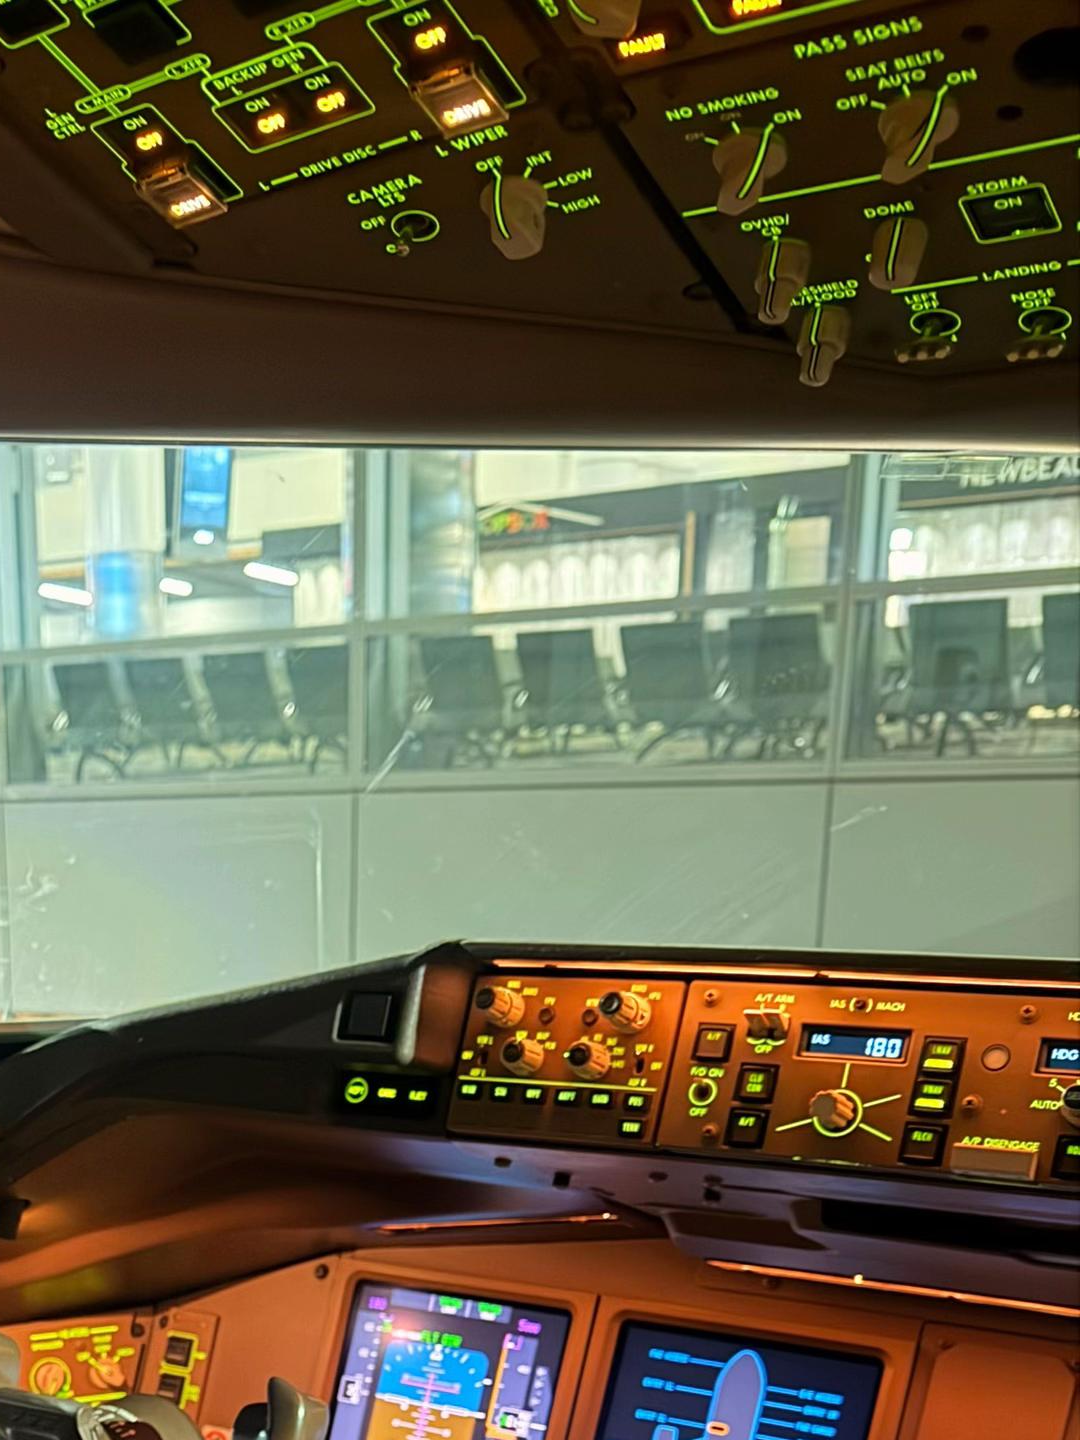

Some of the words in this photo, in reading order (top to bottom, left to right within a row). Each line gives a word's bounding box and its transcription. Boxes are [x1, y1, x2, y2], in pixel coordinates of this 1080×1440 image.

[403, 8, 431, 26] ON
[793, 34, 847, 59] PASS
[852, 16, 922, 45] SIGNS
[212, 62, 267, 91] BACKUP
[271, 48, 306, 68] GEN
[291, 62, 303, 74] R
[845, 61, 888, 82] SEAT
[893, 48, 945, 70] BELTS
[304, 73, 331, 91] ON
[878, 68, 926, 91] AUTO
[945, 68, 978, 86] ON
[231, 86, 243, 96] L
[244, 97, 271, 112] ON
[665, 106, 693, 122] NO
[697, 86, 780, 115] SMOKING
[836, 93, 868, 110] OFF
[46, 112, 76, 131] GEN
[123, 115, 148, 131] ON
[773, 108, 802, 124] ON
[53, 123, 86, 139] CTRL
[410, 130, 423, 141] R
[435, 145, 449, 158] L
[451, 124, 508, 152] WIPER
[299, 156, 342, 178] DRIVE
[342, 145, 377, 163] DISC
[475, 155, 503, 172] OFF
[526, 150, 552, 167] INT
[259, 181, 271, 191] L
[558, 168, 593, 187] LOW
[966, 175, 1027, 196] STORM
[347, 174, 422, 204] CAMERA
[377, 192, 406, 208] LTS
[561, 194, 601, 214] HIGH
[993, 196, 1023, 210] ON
[863, 200, 915, 219] DOME
[360, 215, 387, 231] OFF
[740, 213, 790, 233] OVHD/
[761, 226, 782, 237] CB
[982, 261, 1062, 282] LANDING
[790, 289, 857, 306] L/FLOOD
[903, 291, 938, 305] LEFT
[1010, 287, 1056, 304] NOSE
[1021, 298, 1052, 309] OFF
[911, 300, 940, 311] OFF
[829, 999, 846, 1009] IAS
[875, 1001, 906, 1012] MACH
[754, 1044, 774, 1054] OFF
[810, 1033, 832, 1046] IAS
[863, 1037, 904, 1059] 180
[1050, 1048, 1079, 1061] HDG
[708, 1068, 725, 1078] ON
[689, 1106, 709, 1117] OFF
[1031, 1100, 1059, 1110] AUTO
[961, 1136, 982, 1146] A/P
[983, 1138, 1041, 1152] DISENGAGE
